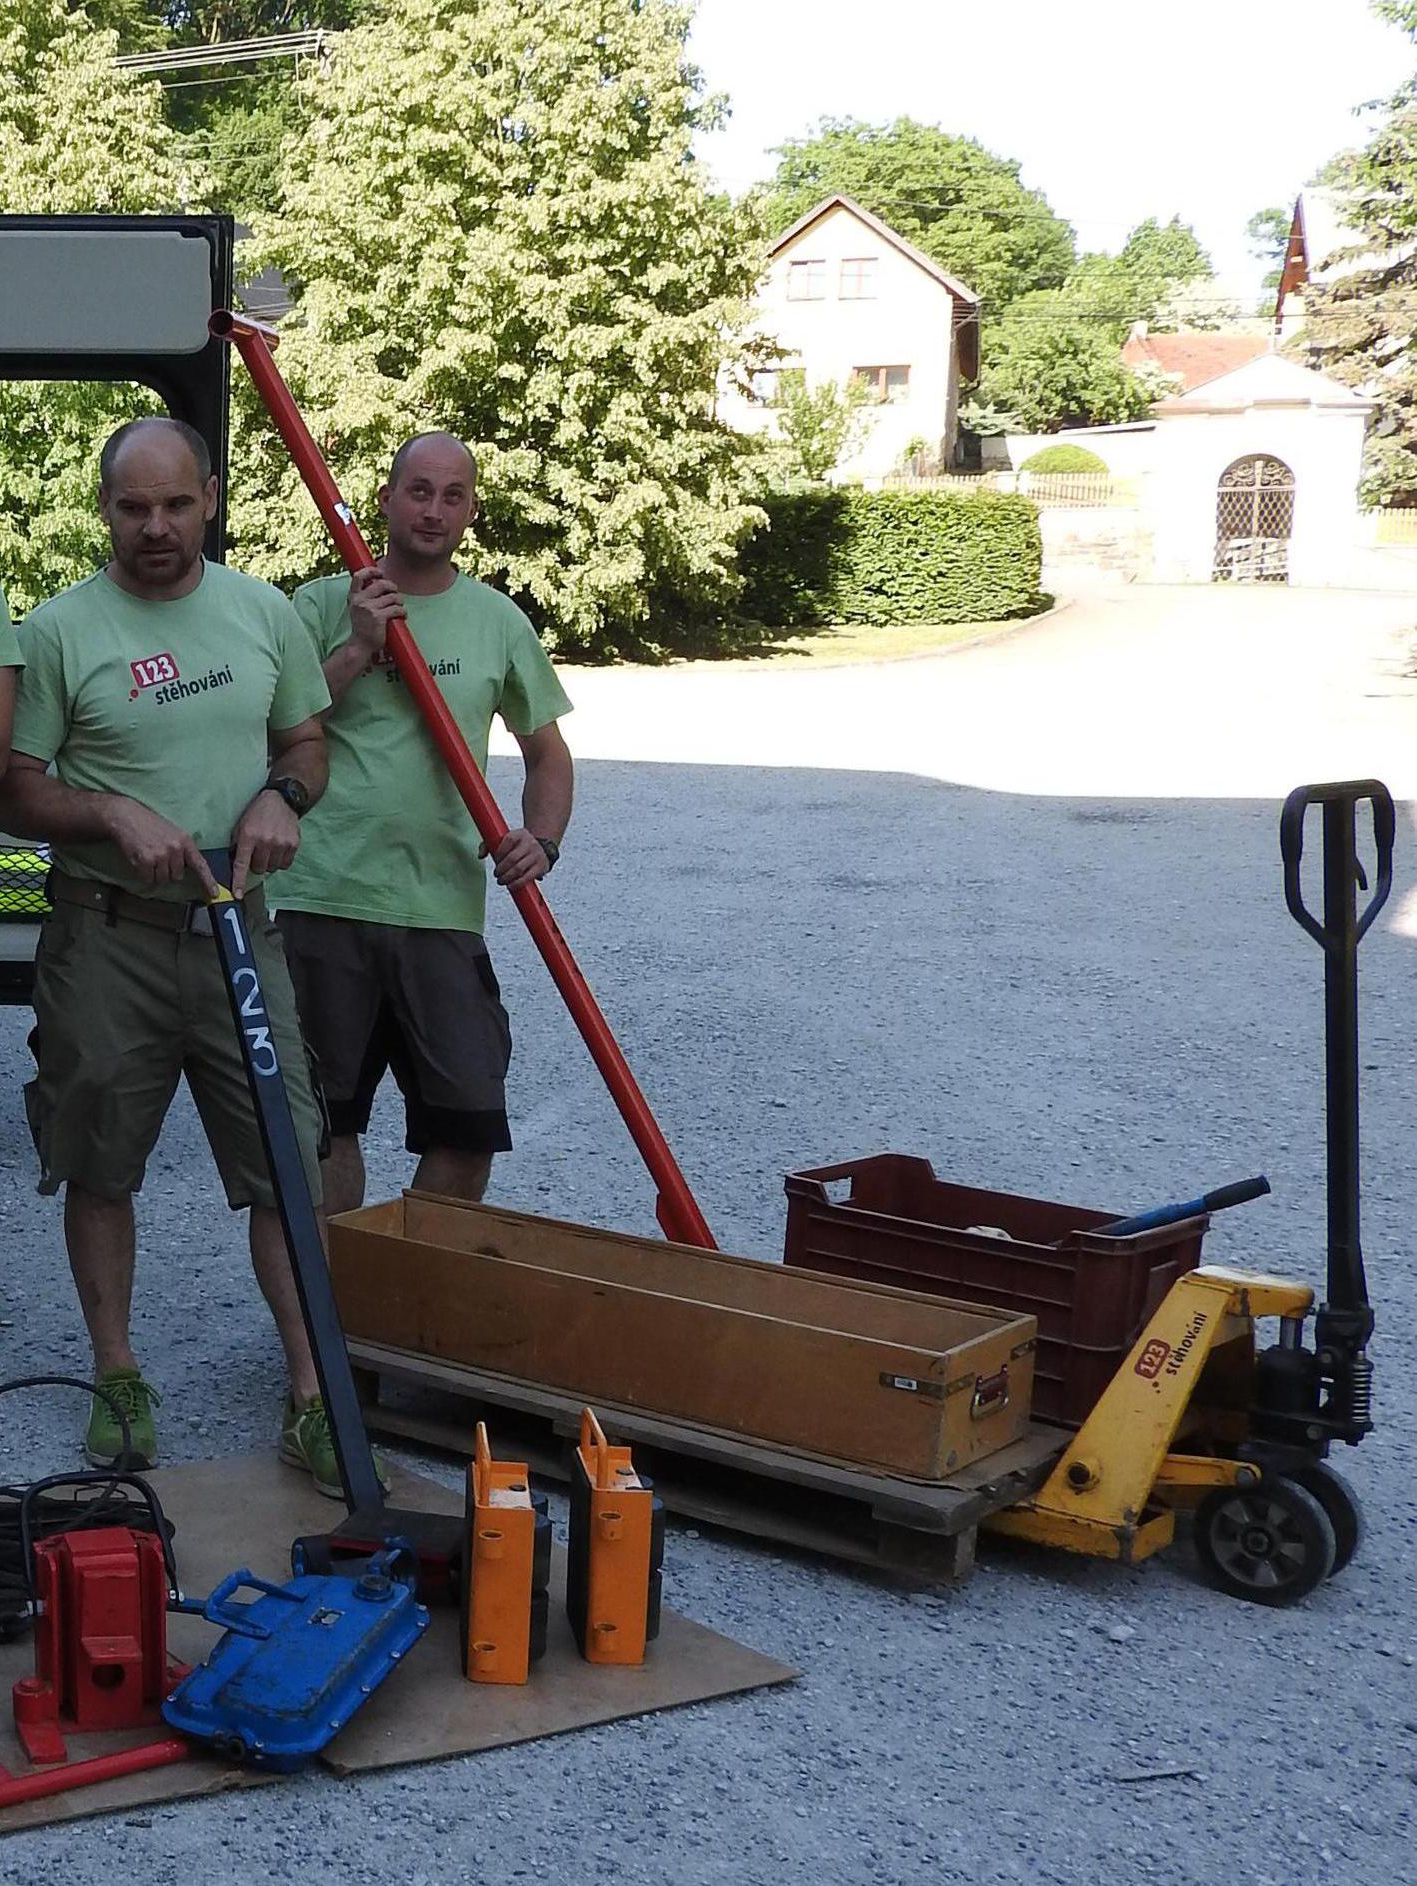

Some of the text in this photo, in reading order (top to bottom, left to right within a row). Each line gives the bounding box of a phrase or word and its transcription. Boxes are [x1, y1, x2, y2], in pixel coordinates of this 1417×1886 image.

[135, 656, 175, 685] 123
[155, 664, 234, 705] stěhování
[386, 658, 461, 682] stvání
[1165, 1310, 1208, 1376] stěhování
[1139, 1344, 1166, 1374] 123
